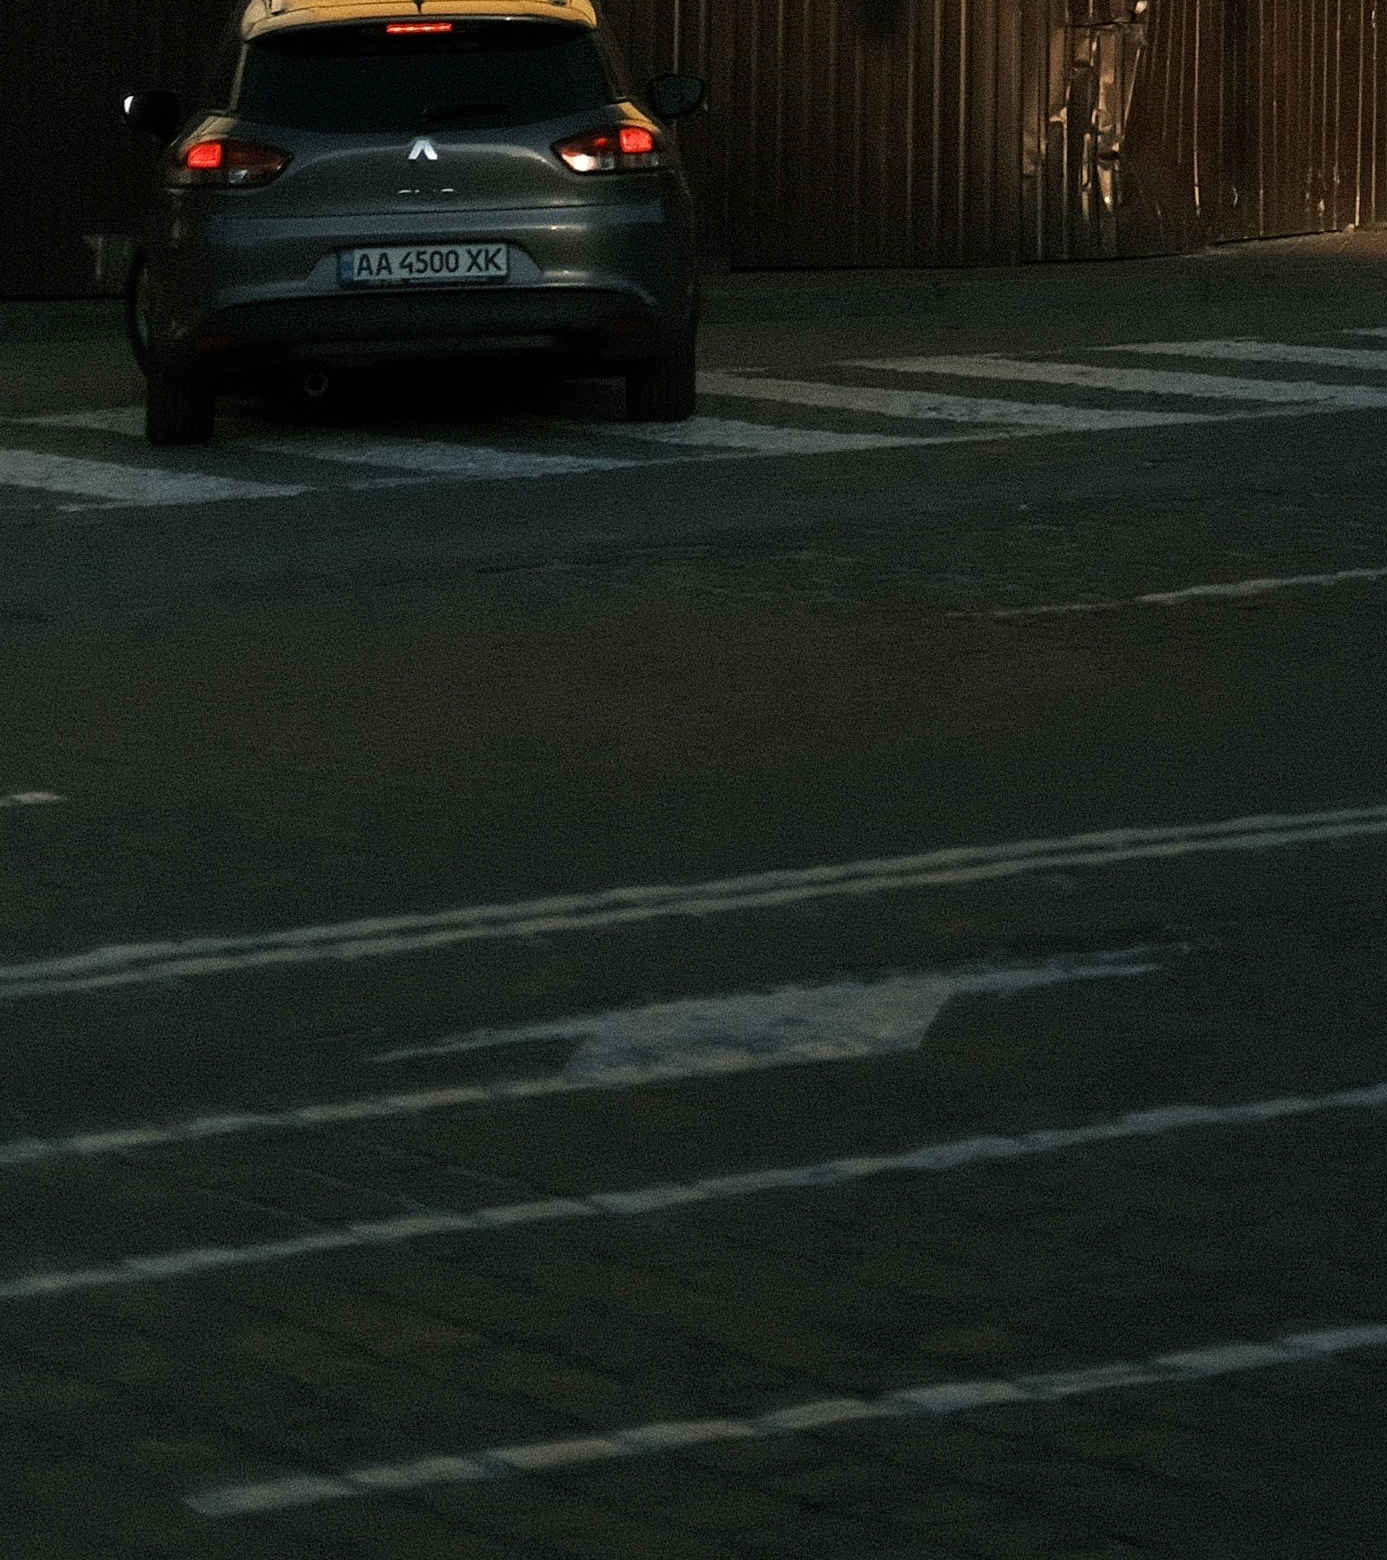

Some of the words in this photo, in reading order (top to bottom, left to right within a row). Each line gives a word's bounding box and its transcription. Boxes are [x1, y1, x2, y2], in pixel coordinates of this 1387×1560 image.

[357, 252, 392, 276] AA
[399, 249, 459, 274] 4500
[466, 247, 503, 273] XK
